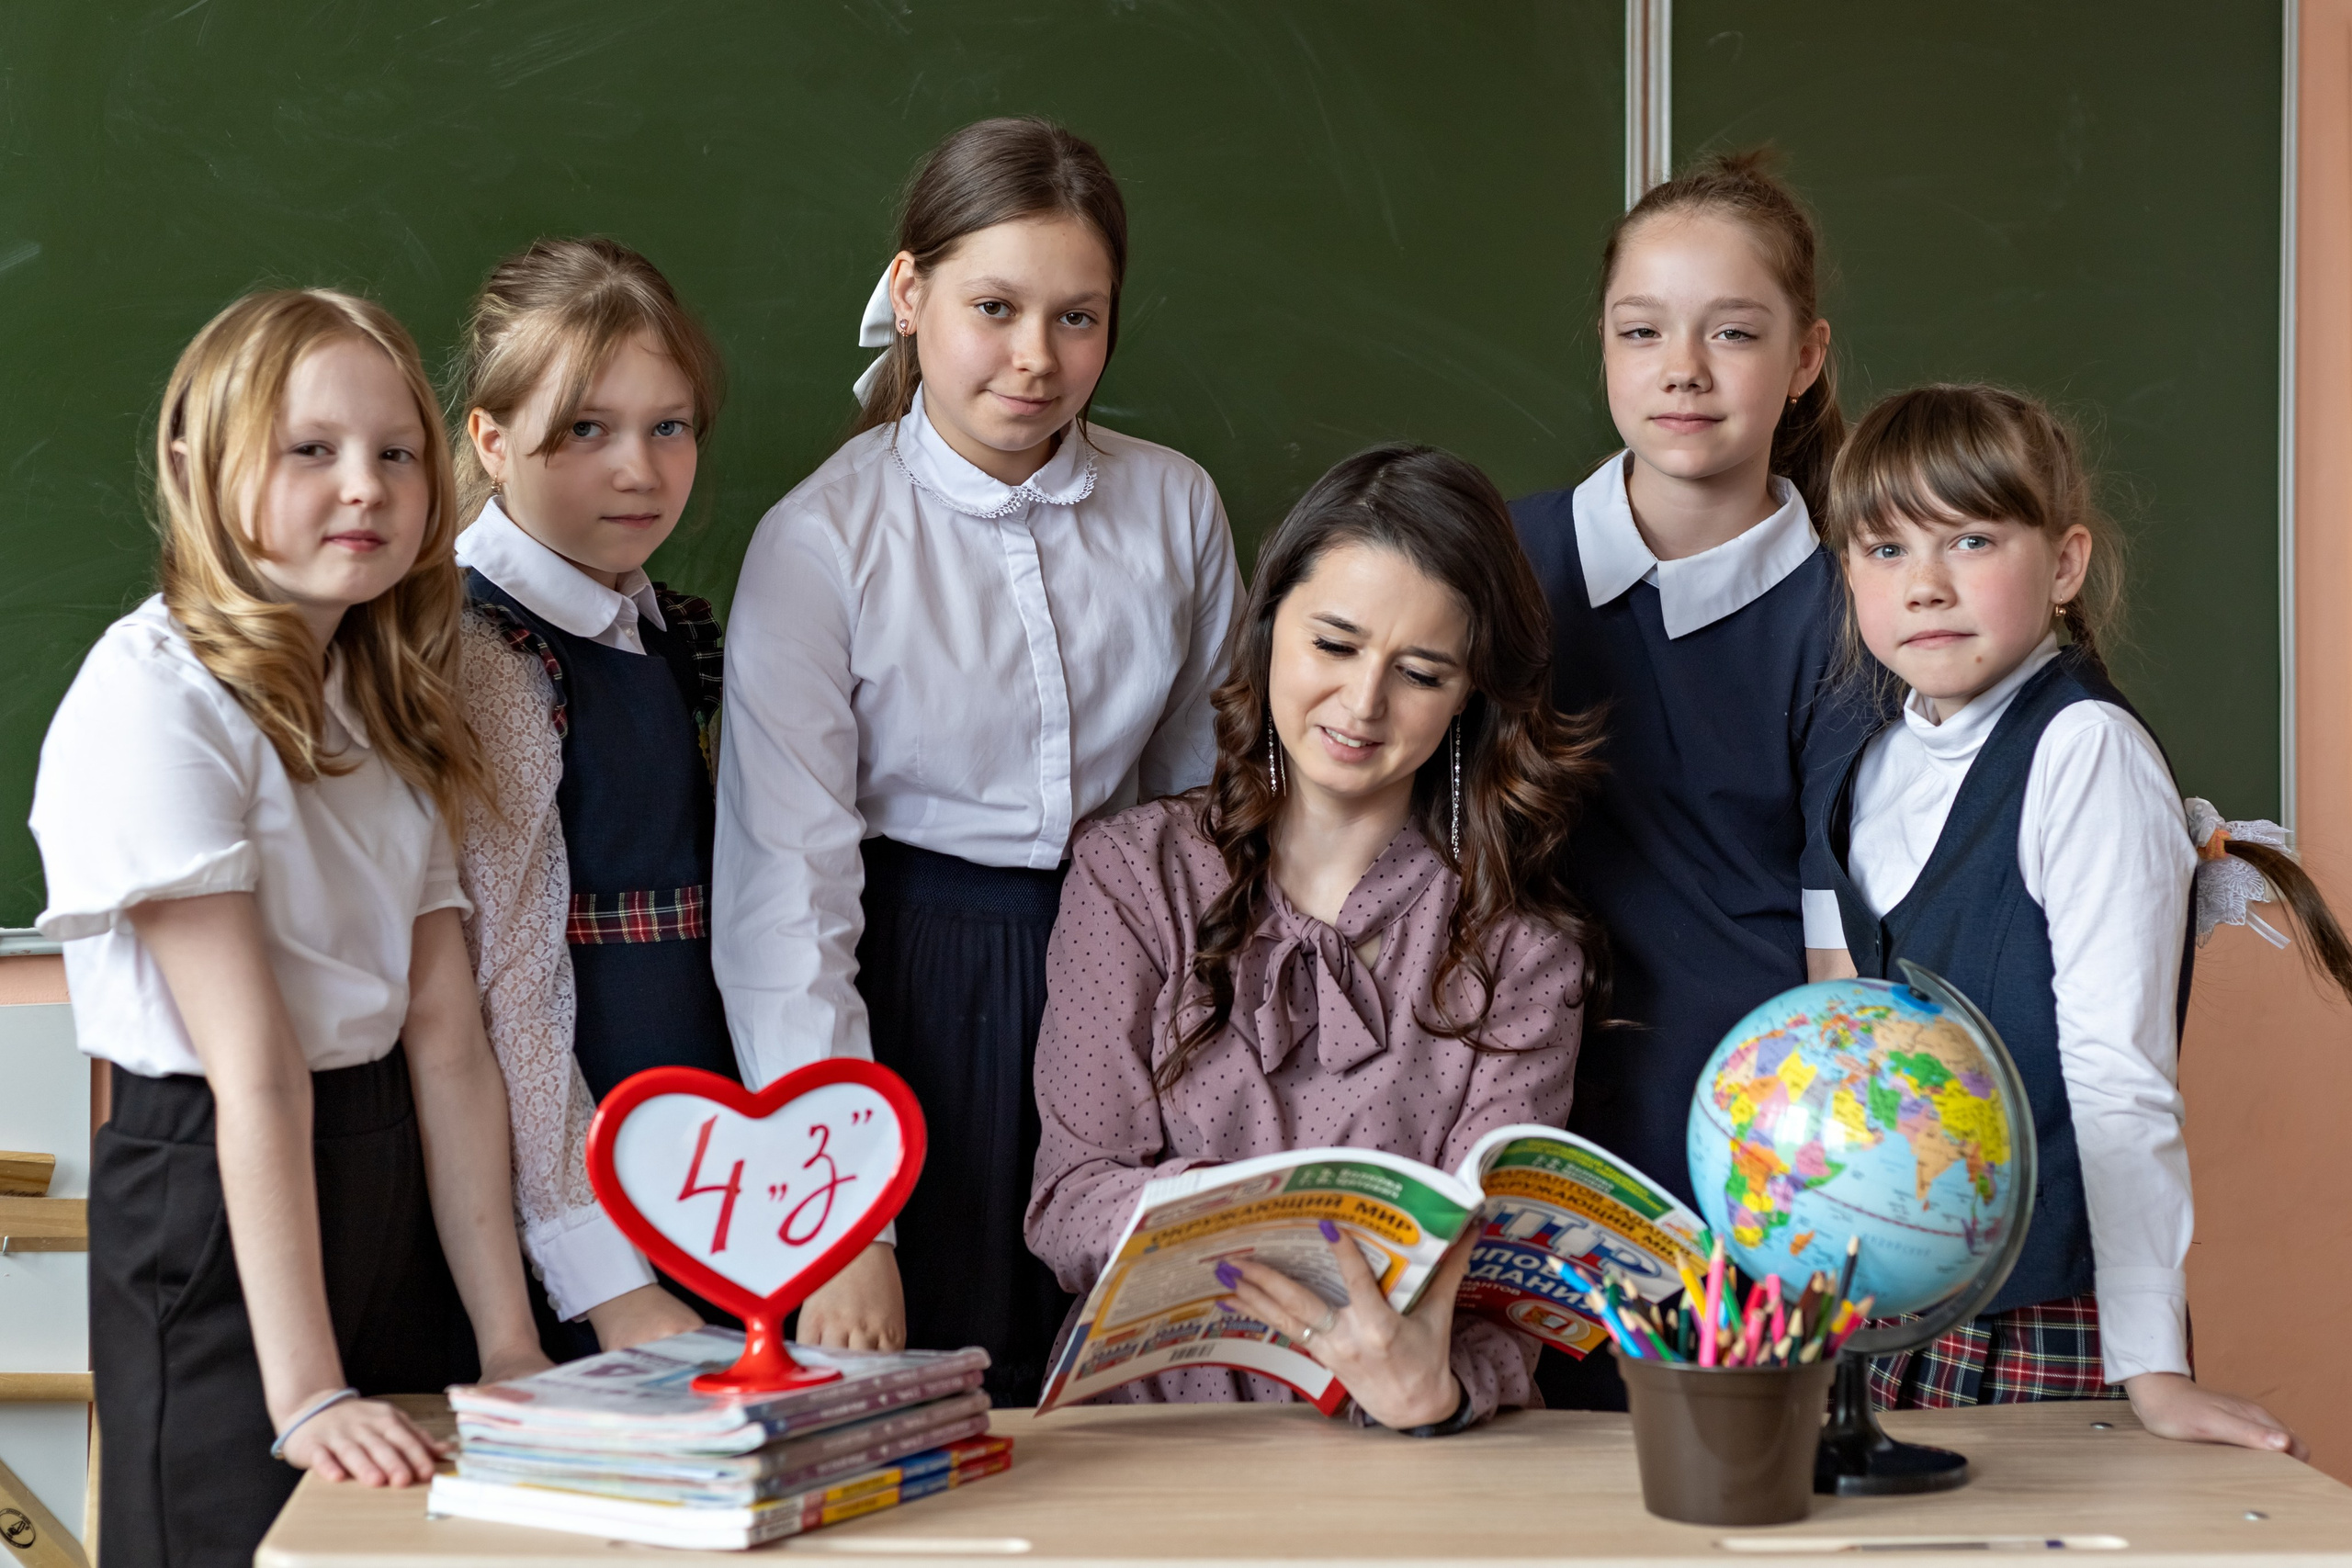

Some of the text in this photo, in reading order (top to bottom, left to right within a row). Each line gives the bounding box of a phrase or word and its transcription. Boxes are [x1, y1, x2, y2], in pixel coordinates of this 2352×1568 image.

[676, 1113, 746, 1257] 4
[1354, 1200, 1413, 1233] МИР
[1469, 1263, 1590, 1310] ДАНИ
